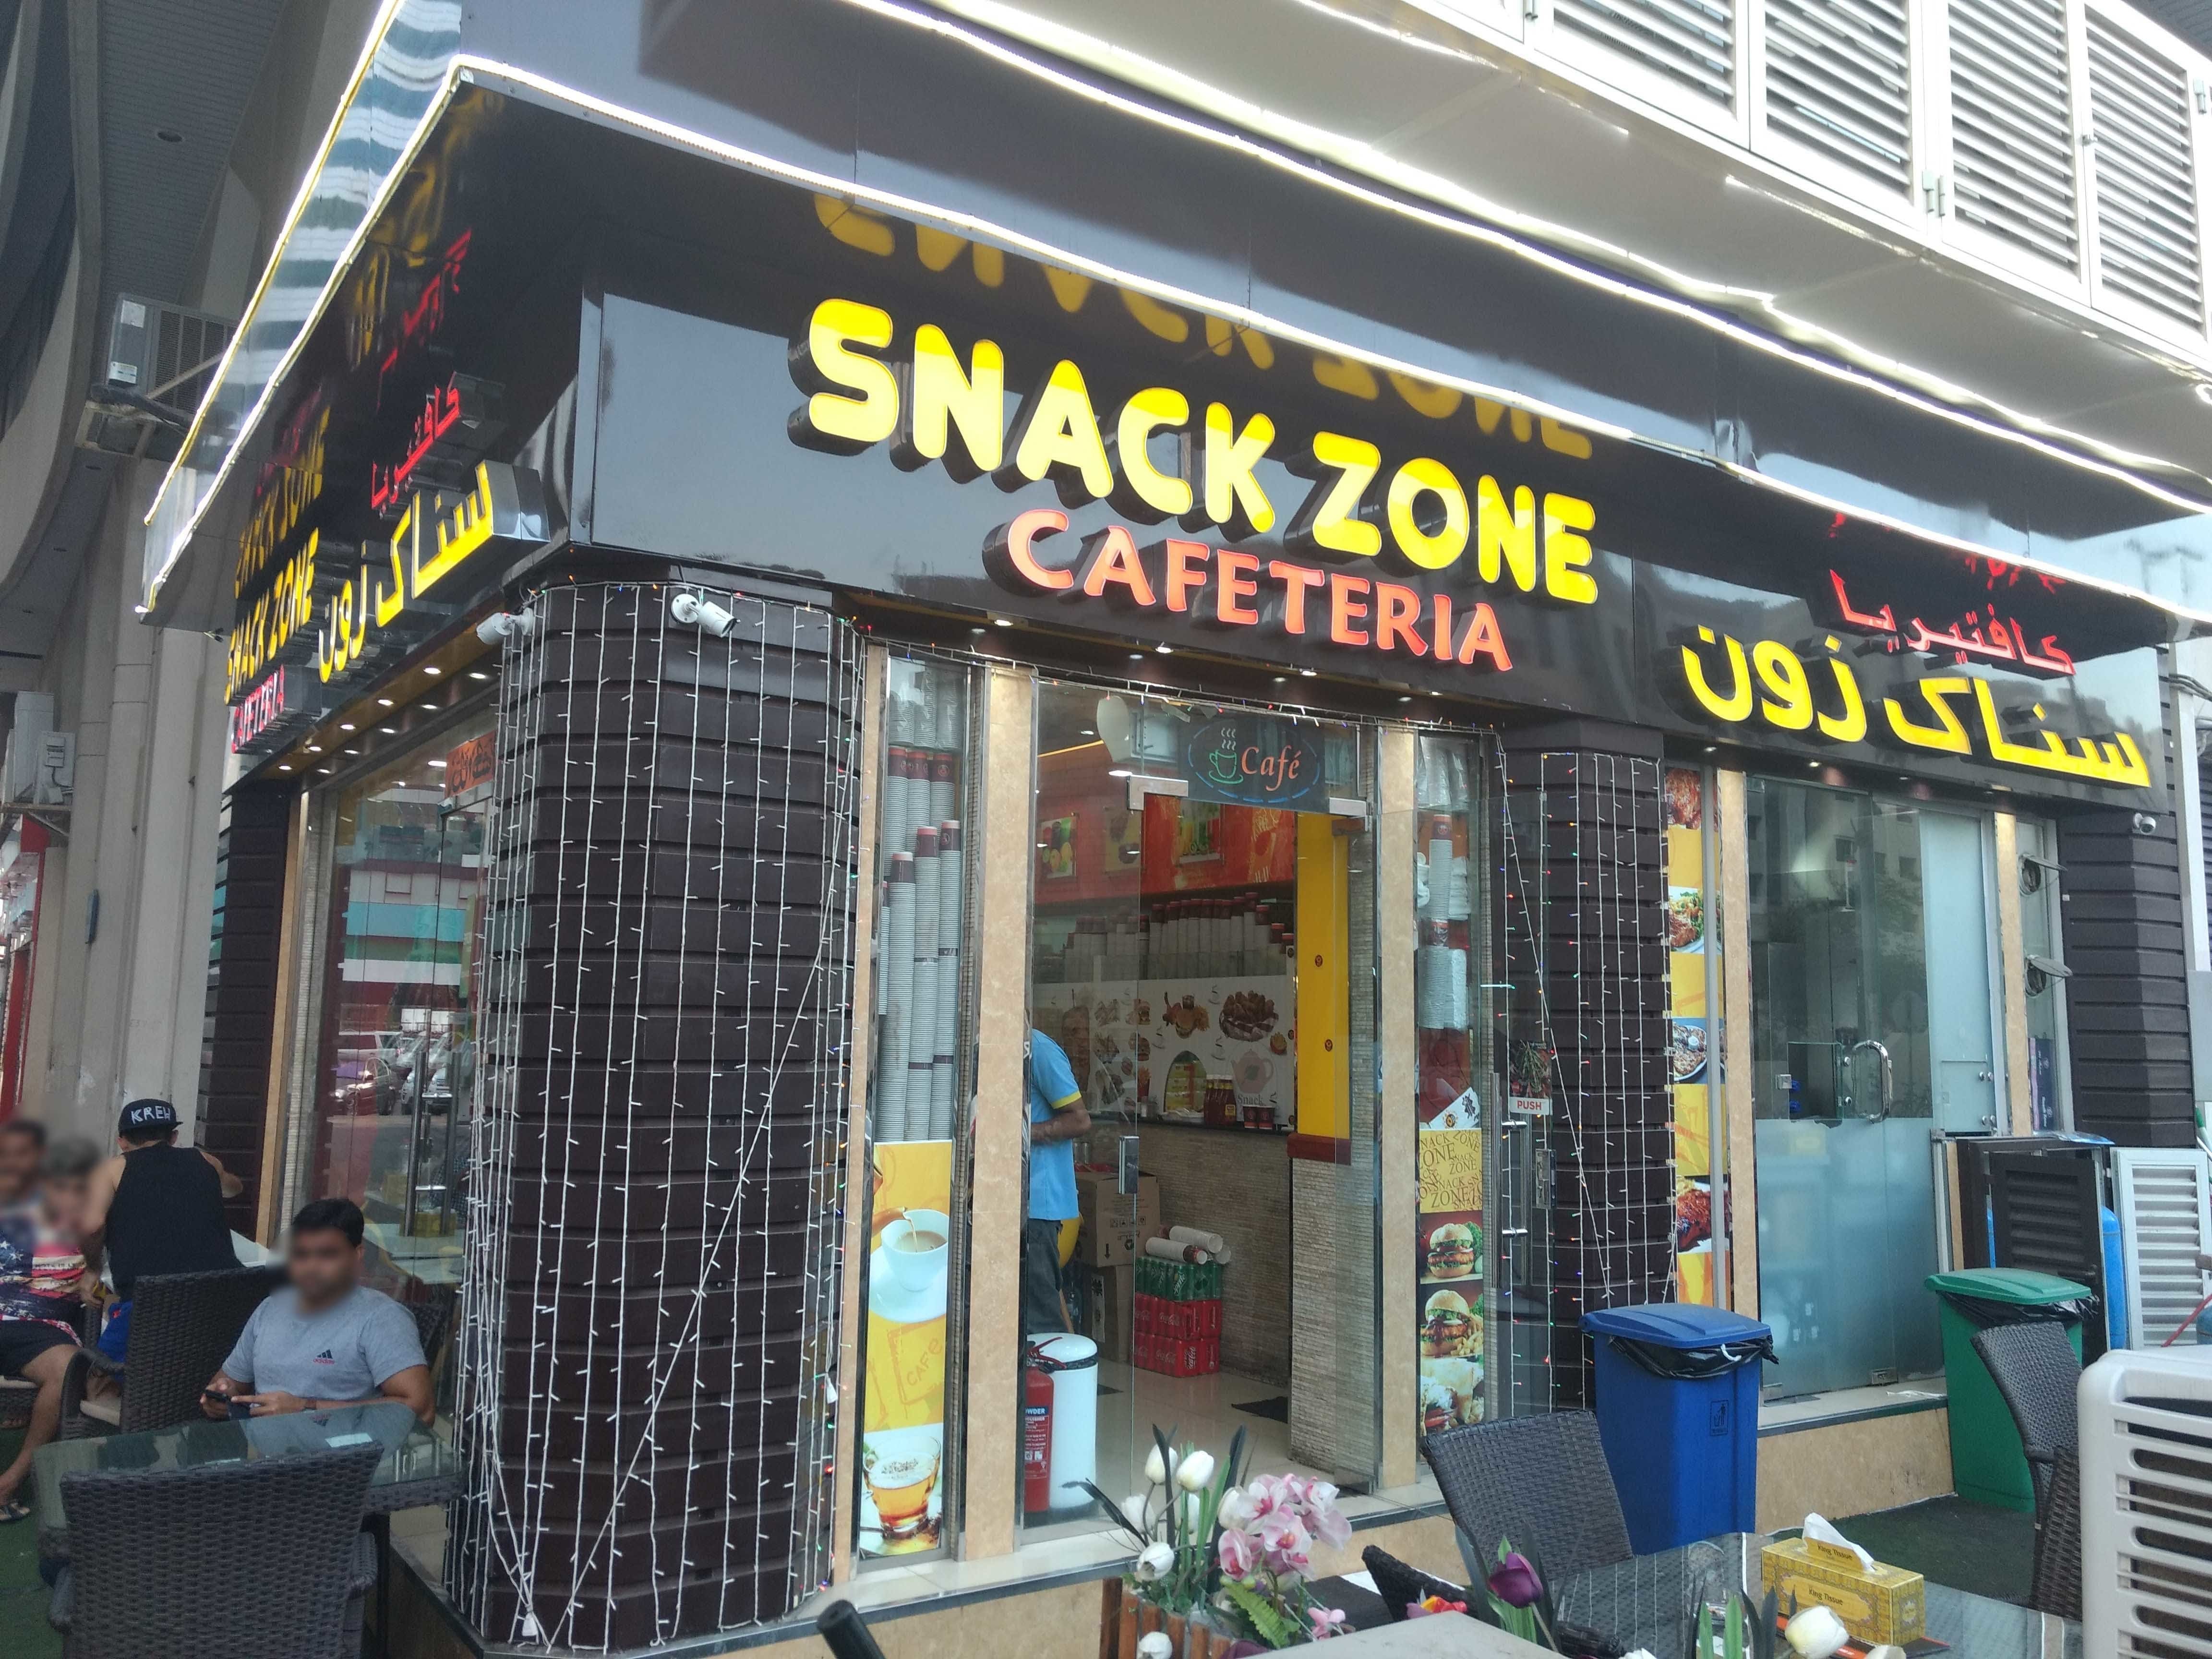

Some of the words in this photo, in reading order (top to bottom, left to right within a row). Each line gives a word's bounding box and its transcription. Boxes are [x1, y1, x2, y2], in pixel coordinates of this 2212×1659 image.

[809, 299, 1275, 534] SNACK
[1312, 431, 1598, 604] ZONE
[376, 460, 493, 627] سناك
[320, 540, 368, 684] زون
[1007, 508, 1514, 672] CAFETERIA
[224, 588, 270, 706] SNACK
[267, 527, 319, 661] ZONE
[1681, 624, 1867, 743] زون
[1883, 676, 2151, 788] سناك
[1241, 745, 1301, 792] Café
[1517, 1100, 1542, 1110] PUSH
[1420, 1132, 1450, 1150] NACK
[1420, 1142, 1455, 1169] ONE
[1449, 1159, 1477, 1175] ZONE
[1431, 1186, 1469, 1208] ZONE
[1817, 1544, 1832, 1556] King
[1808, 1587, 1823, 1600] King
